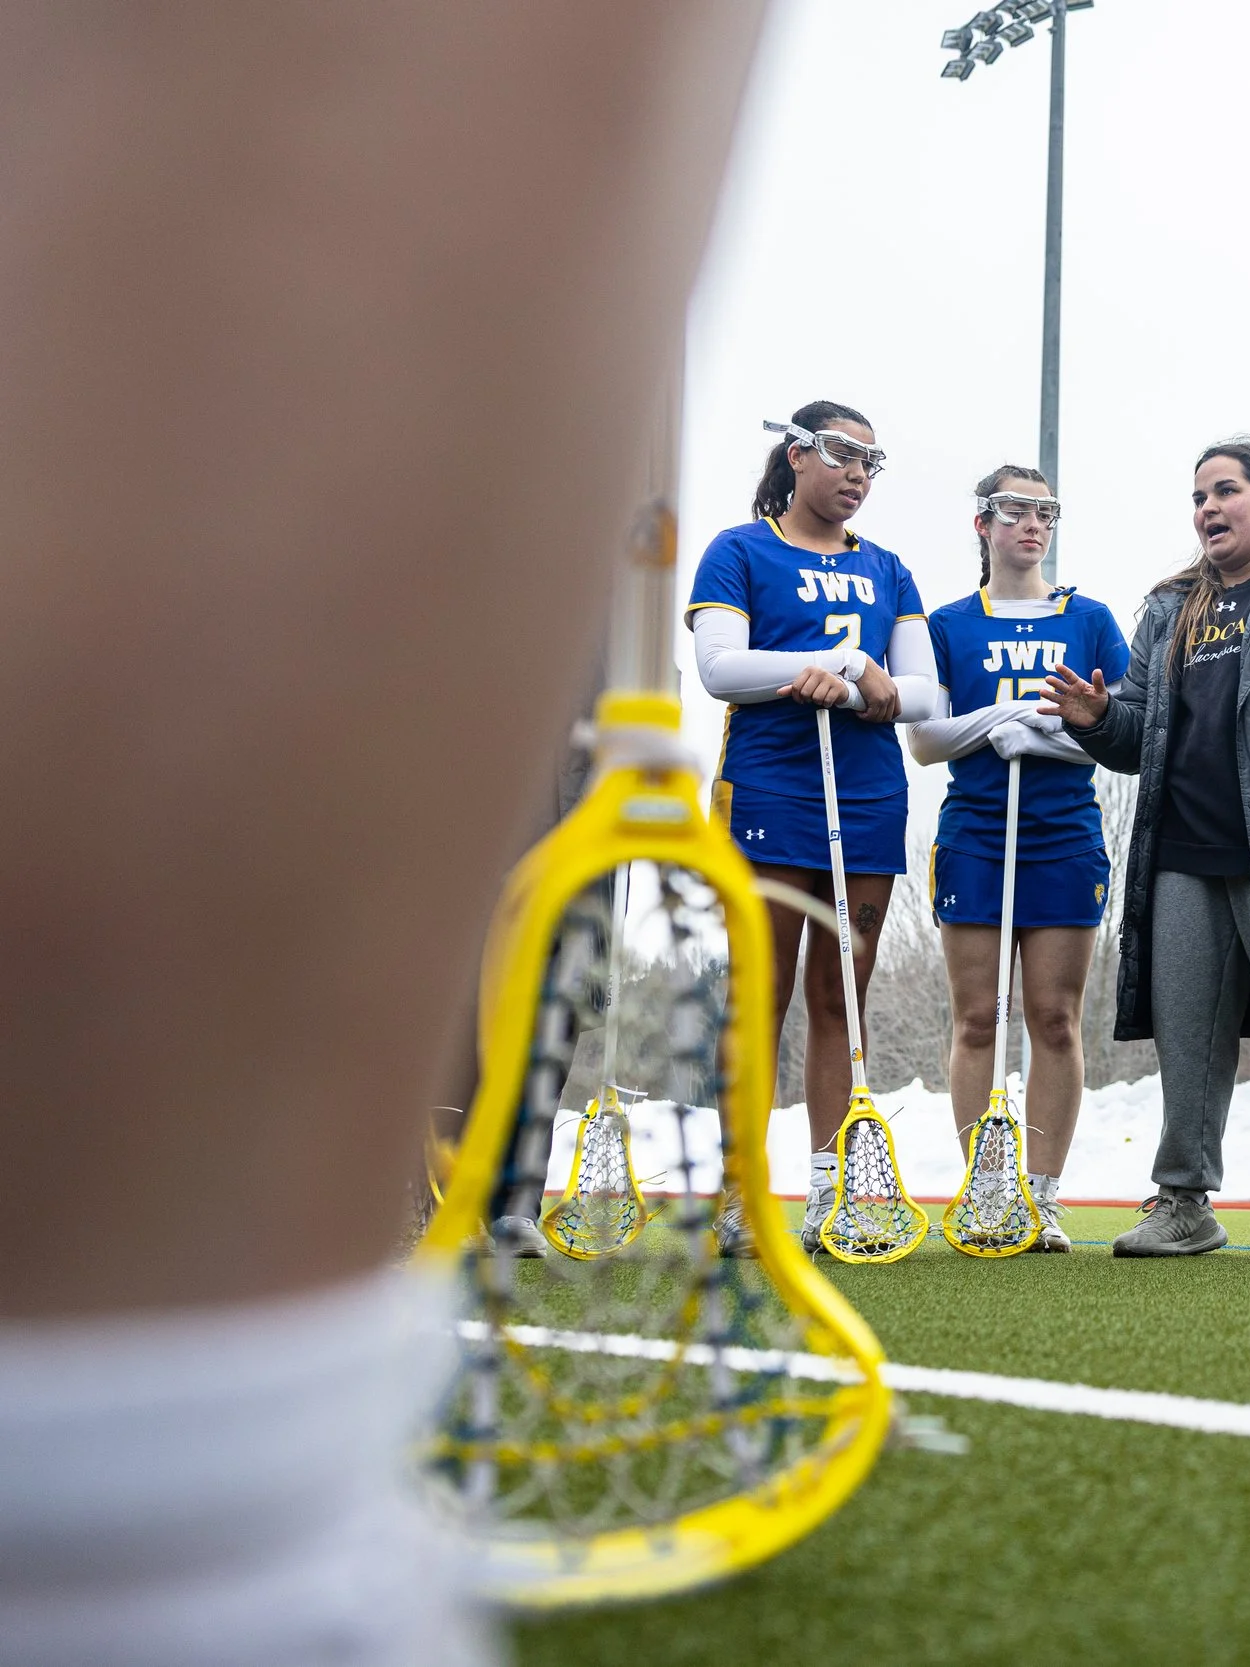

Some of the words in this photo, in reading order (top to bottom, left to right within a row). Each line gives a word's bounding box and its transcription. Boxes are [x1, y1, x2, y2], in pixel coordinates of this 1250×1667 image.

[797, 569, 876, 605] JWU
[825, 613, 861, 650] 2
[983, 641, 1067, 672] JWU
[838, 899, 849, 953] WILDCATS
